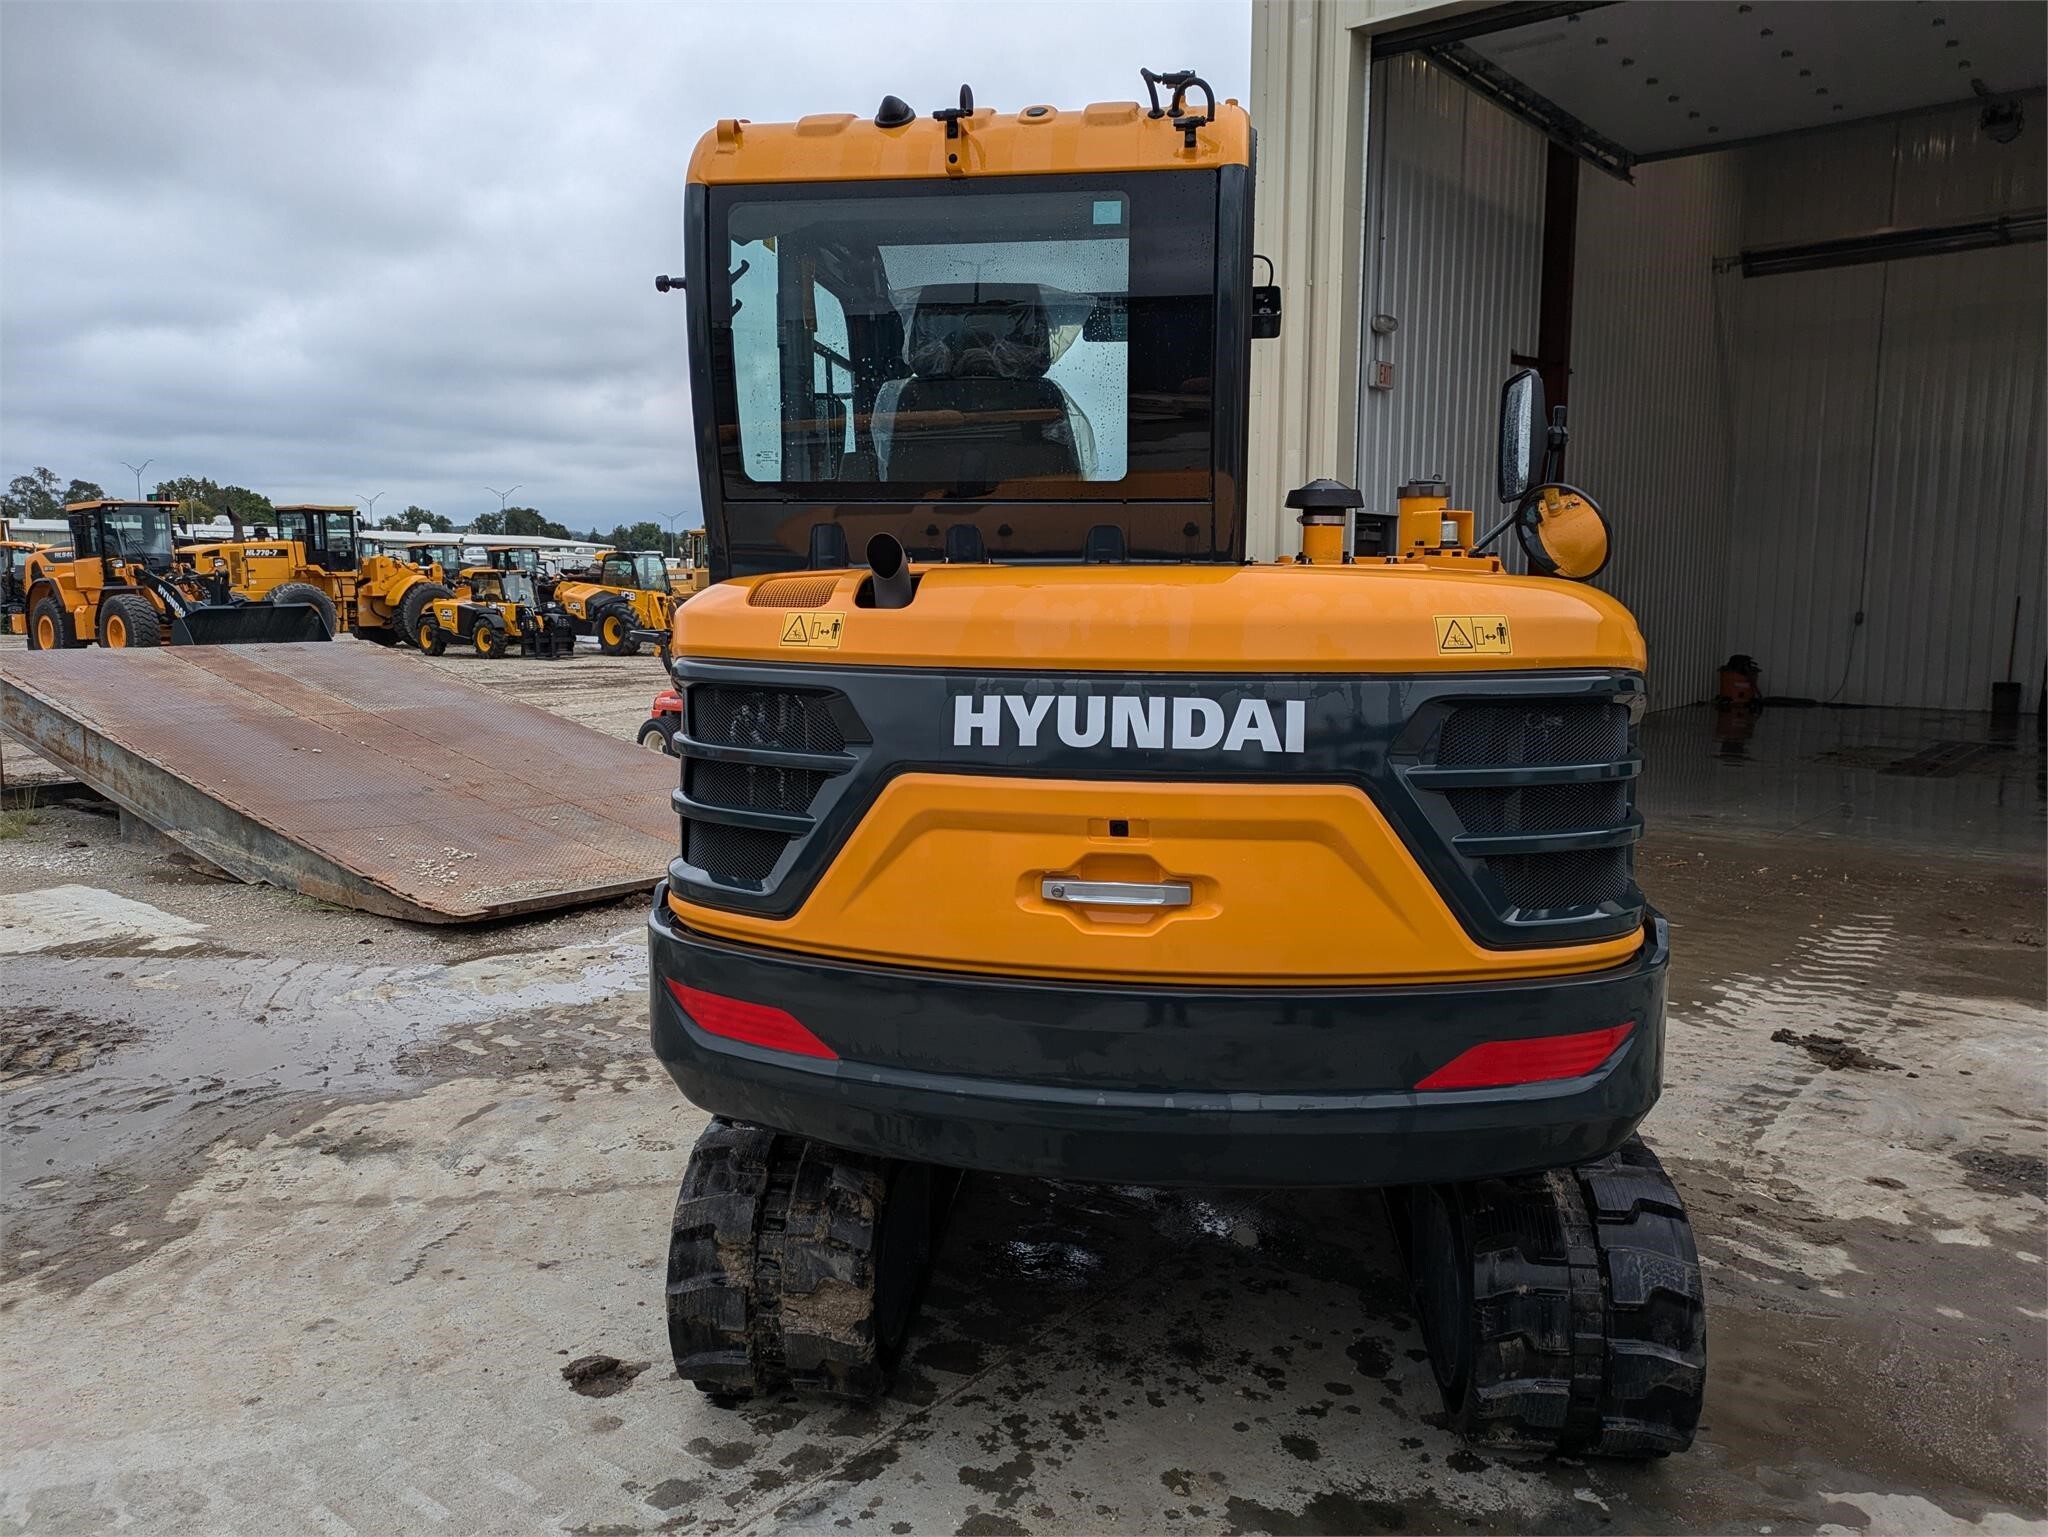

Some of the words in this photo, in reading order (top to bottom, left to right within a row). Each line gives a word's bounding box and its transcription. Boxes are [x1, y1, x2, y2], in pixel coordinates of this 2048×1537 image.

[1379, 364, 1392, 385] EXIT
[158, 584, 186, 617] HYUNDAI
[953, 695, 1306, 753] HYUNDAI
